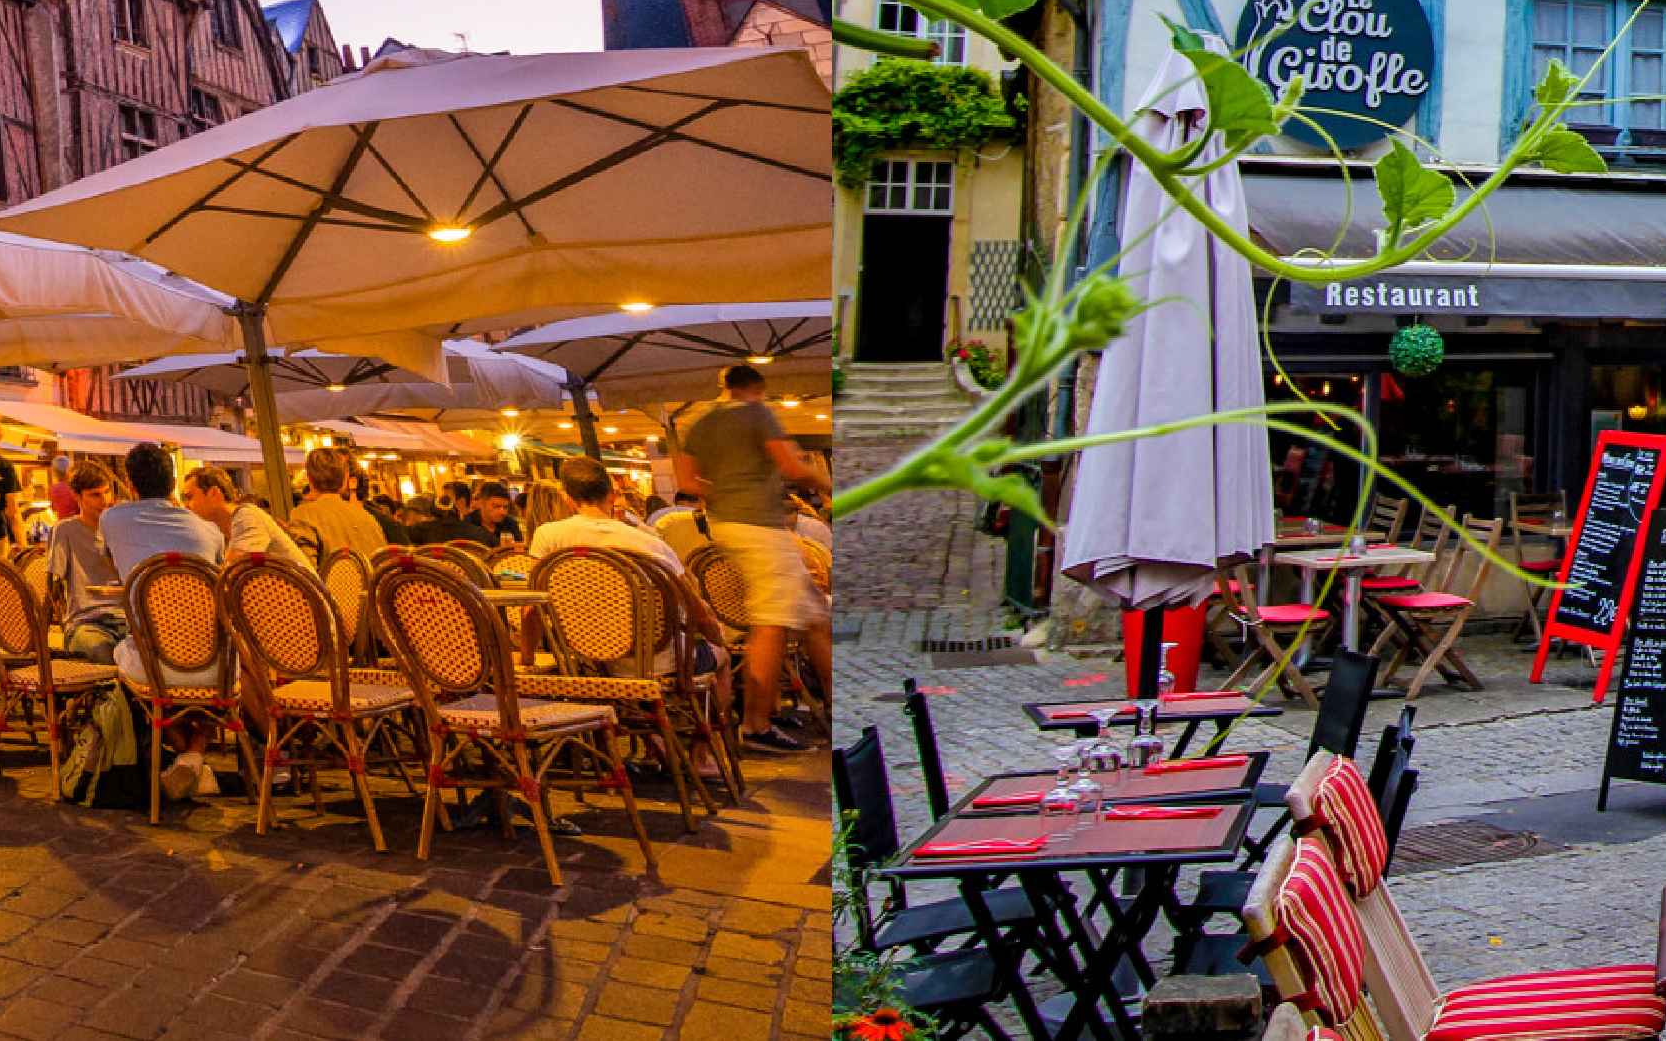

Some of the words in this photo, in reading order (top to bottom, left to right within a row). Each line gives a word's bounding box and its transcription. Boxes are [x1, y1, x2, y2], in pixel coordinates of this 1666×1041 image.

[1320, 36, 1352, 62] de
[1267, 46, 1428, 108] Girofle
[1326, 282, 1480, 307] Restaurant
